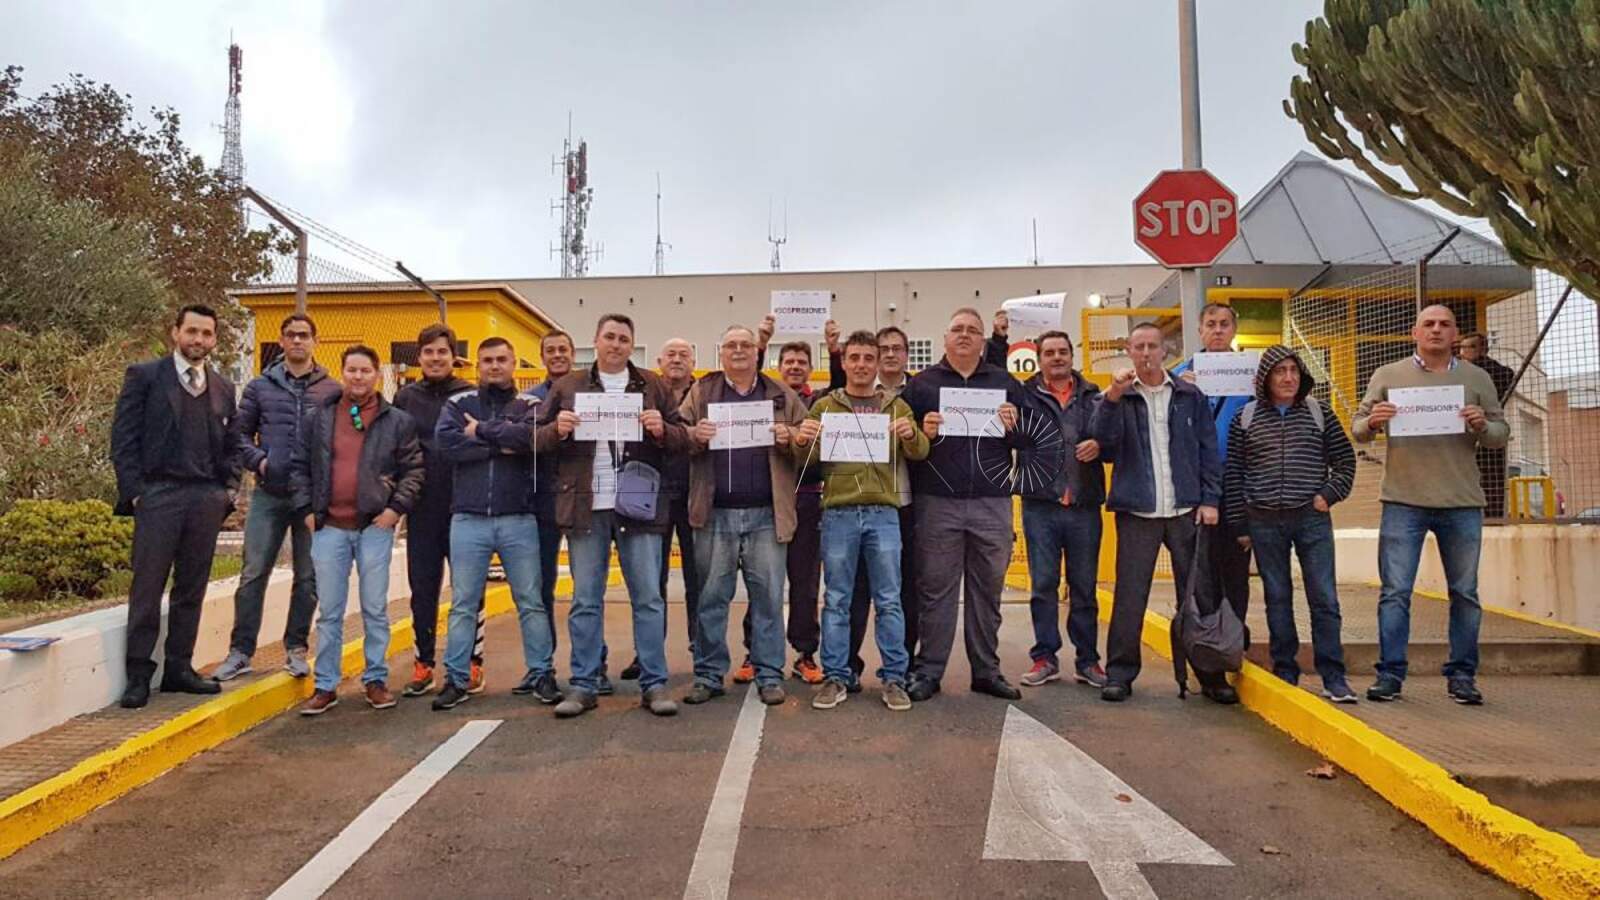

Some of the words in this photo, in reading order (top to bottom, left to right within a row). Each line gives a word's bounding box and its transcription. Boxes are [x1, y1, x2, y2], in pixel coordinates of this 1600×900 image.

[1141, 199, 1233, 237] STOP
[1013, 358, 1036, 372] 10
[944, 406, 996, 415] #SOSPRISIONE
[1397, 404, 1460, 414] SOSPRISIONES
[716, 418, 770, 429] SOSPRISIONES
